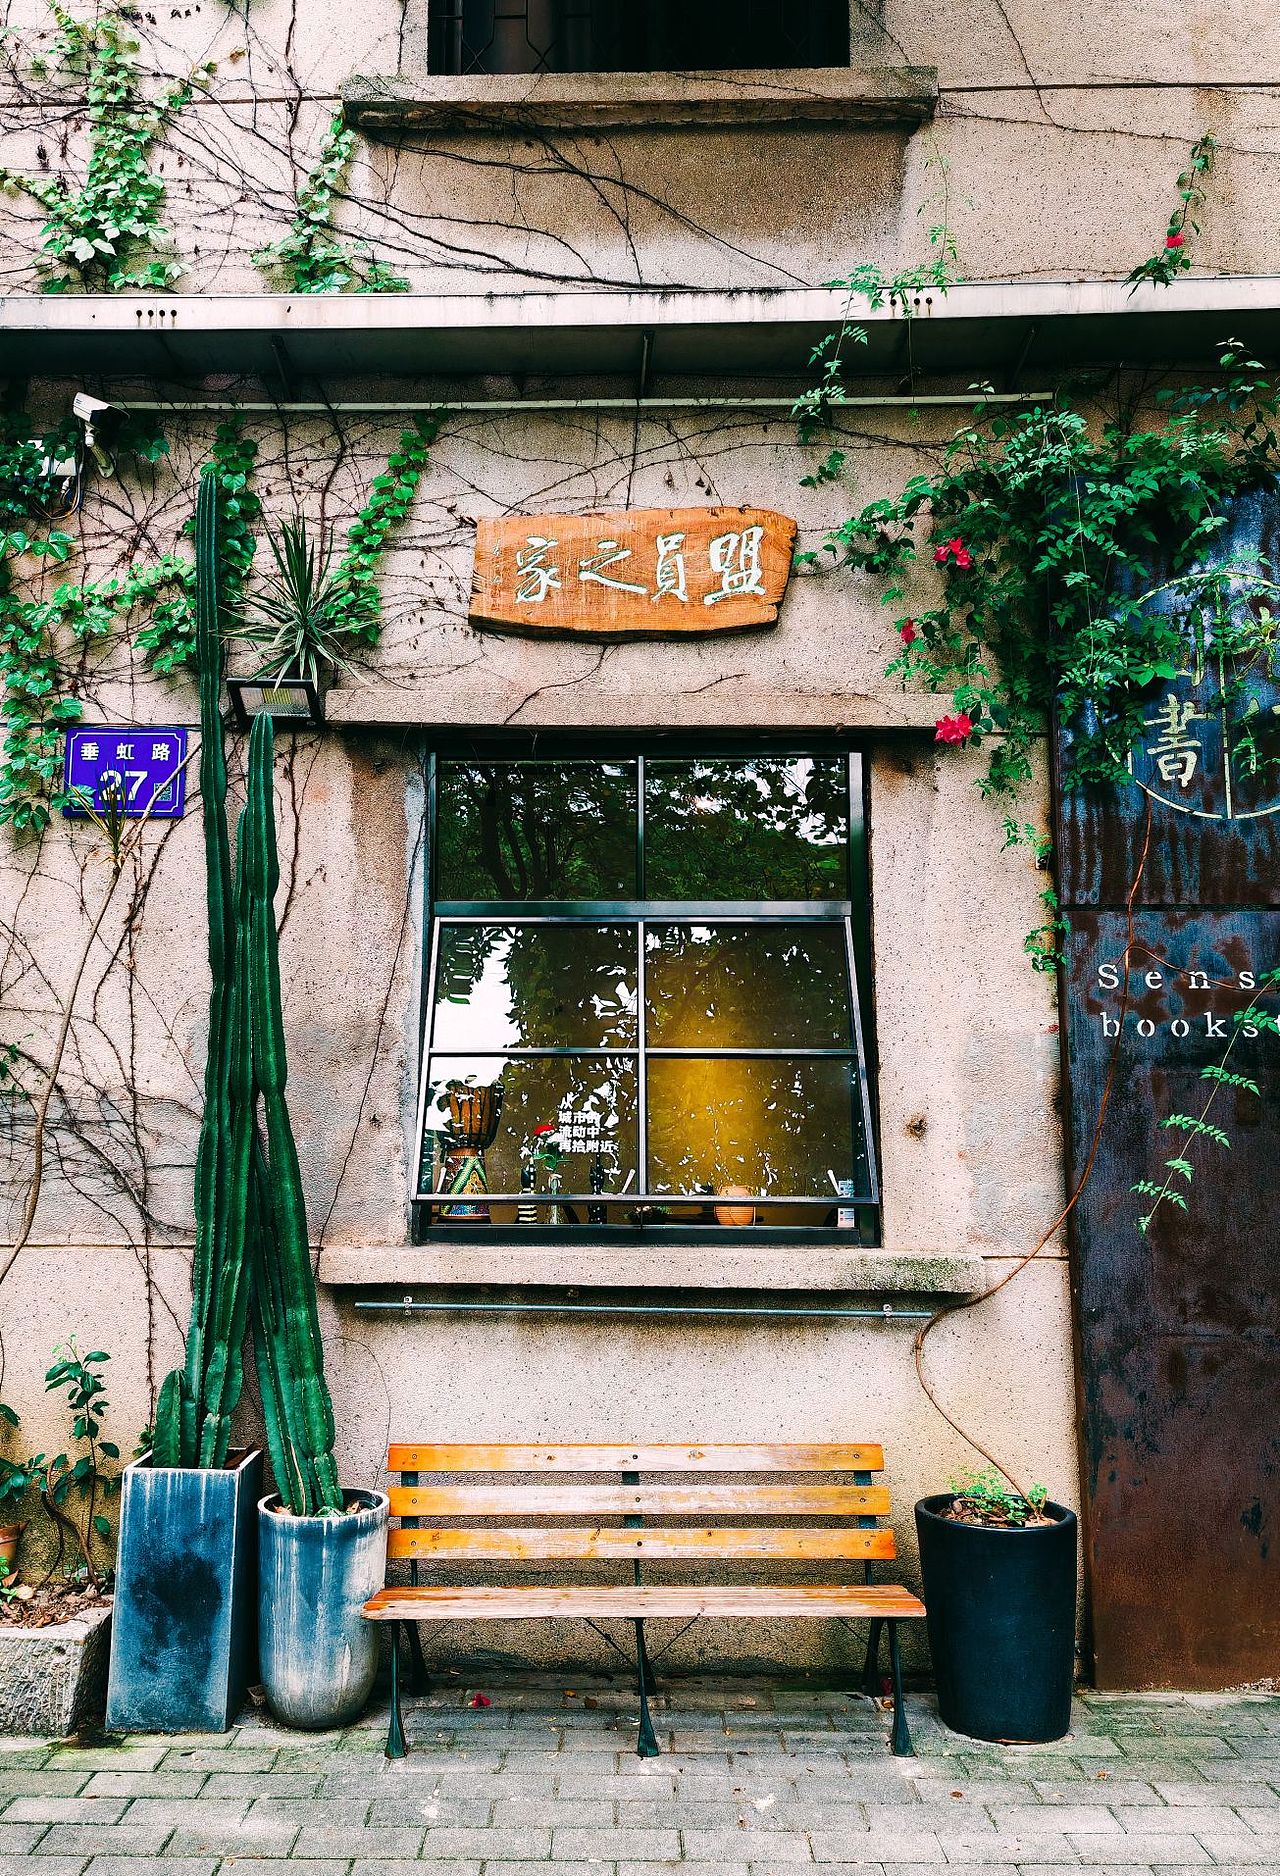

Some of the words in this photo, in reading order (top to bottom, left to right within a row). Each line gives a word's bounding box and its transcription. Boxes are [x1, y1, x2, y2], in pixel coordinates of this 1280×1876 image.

[80, 742, 171, 761] 垂虹路
[99, 770, 148, 801] 27
